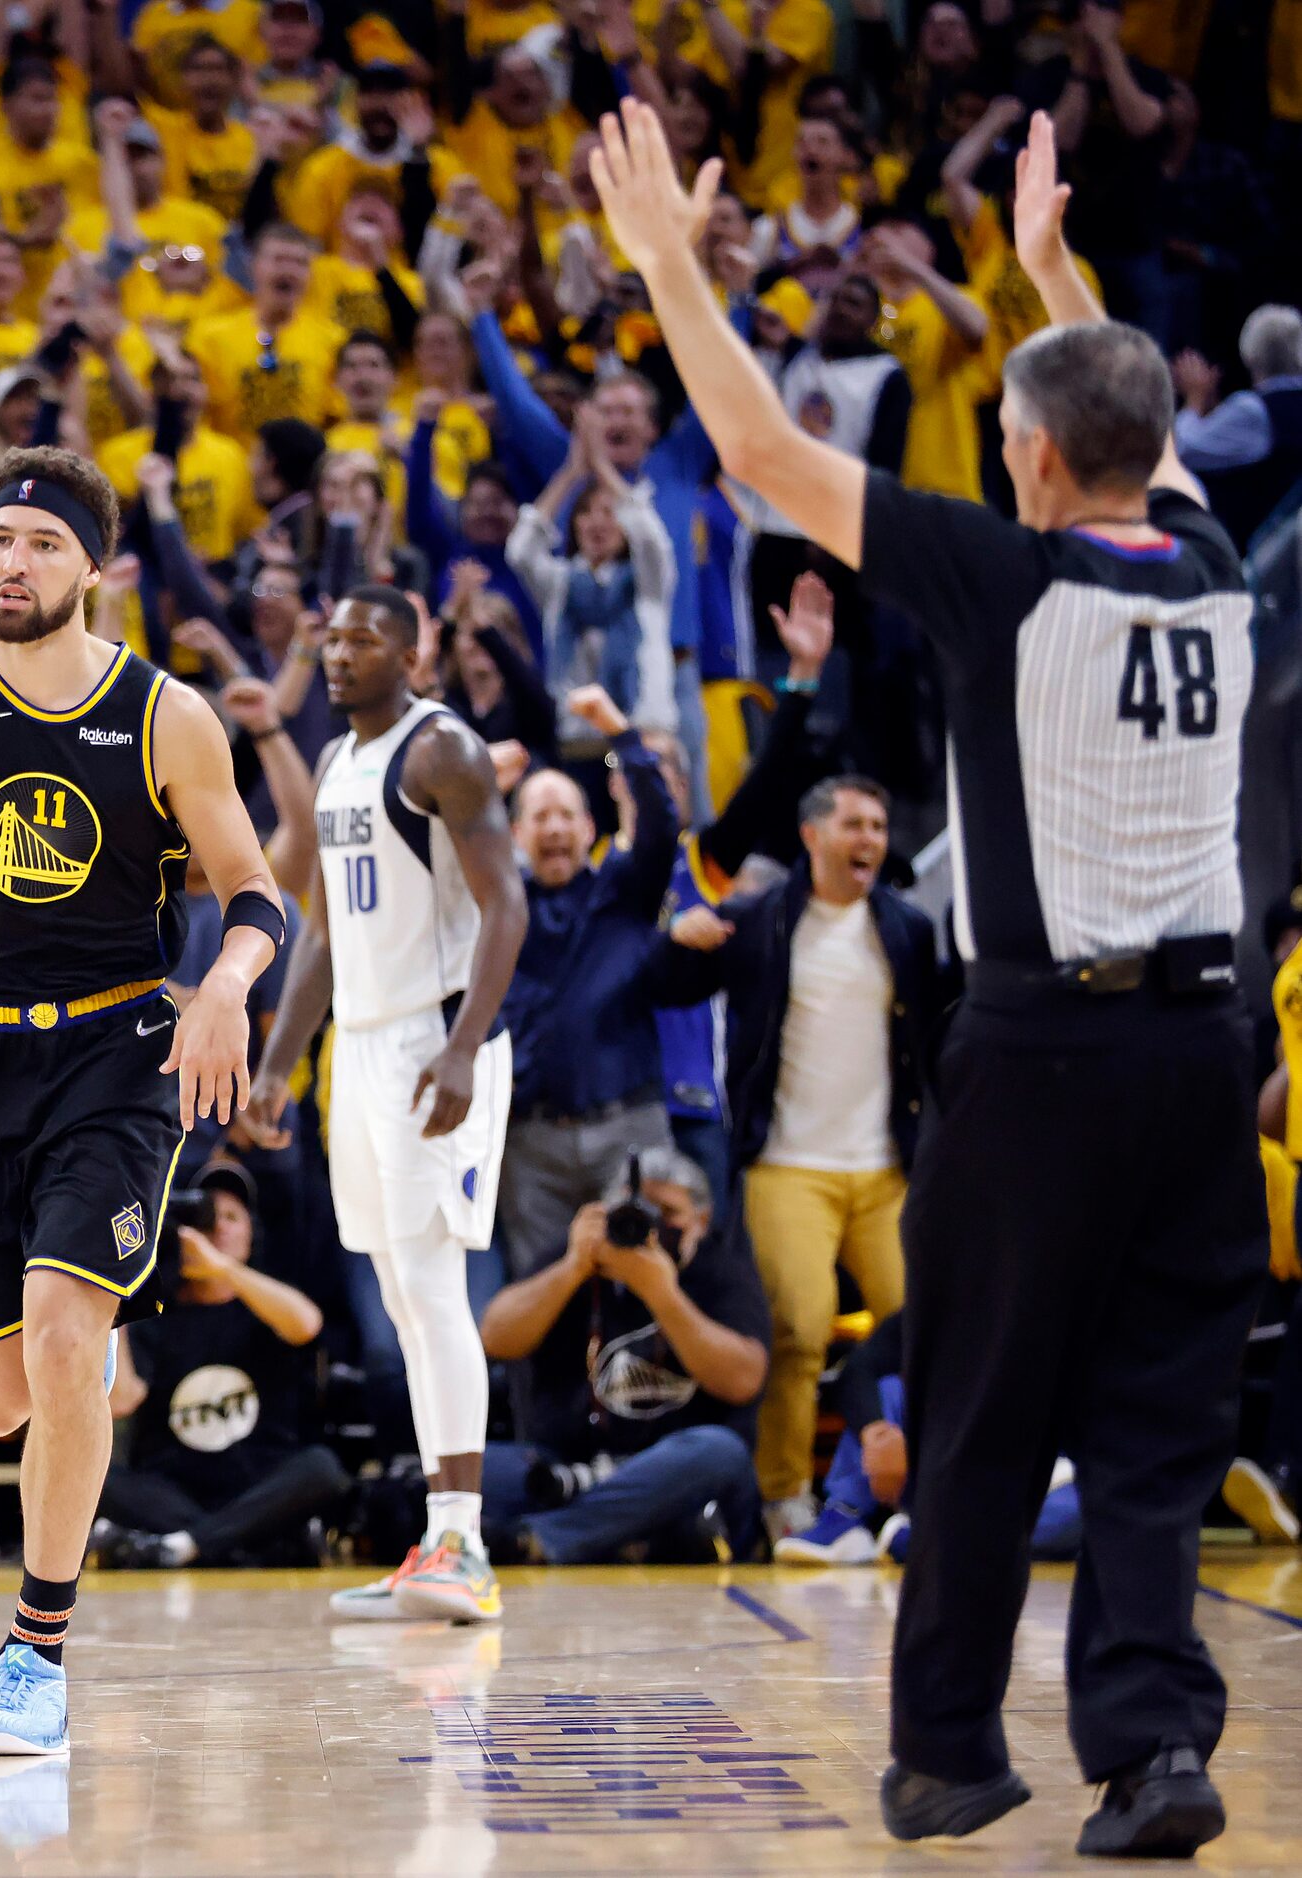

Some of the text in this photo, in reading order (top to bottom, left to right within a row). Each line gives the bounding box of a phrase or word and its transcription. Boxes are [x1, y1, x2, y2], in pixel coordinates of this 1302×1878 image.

[1118, 622, 1217, 740] 48
[78, 726, 133, 746] Rakuten
[33, 788, 67, 829] 11
[344, 855, 377, 915] 10
[174, 1390, 257, 1427] TNT
